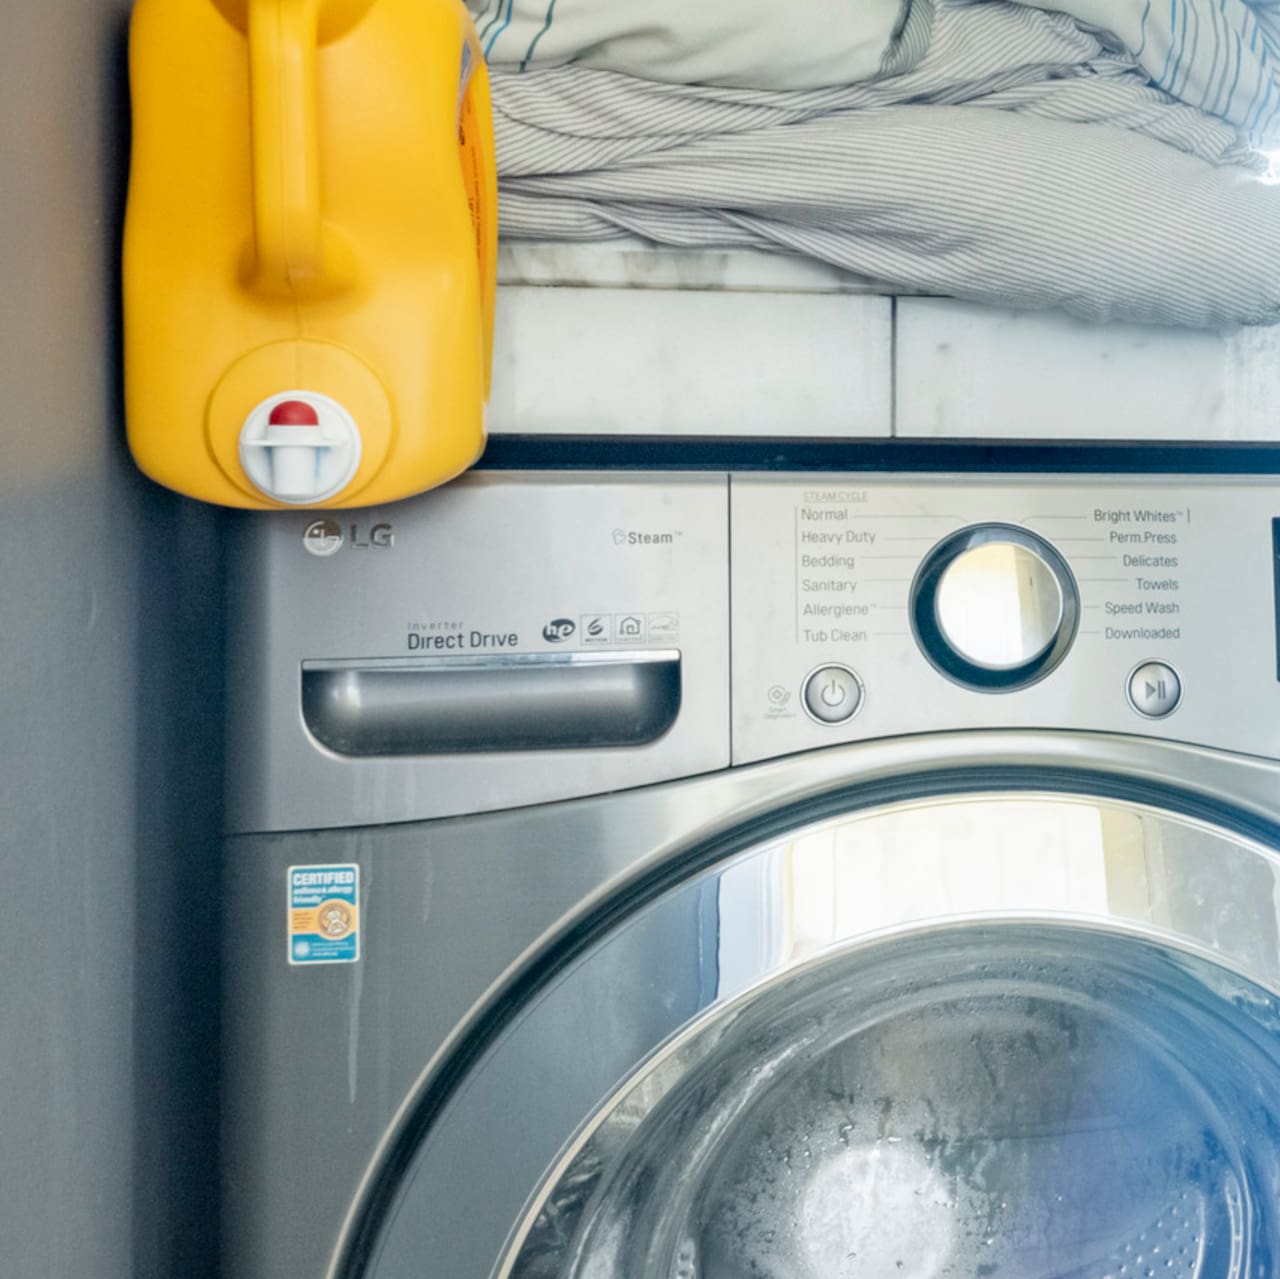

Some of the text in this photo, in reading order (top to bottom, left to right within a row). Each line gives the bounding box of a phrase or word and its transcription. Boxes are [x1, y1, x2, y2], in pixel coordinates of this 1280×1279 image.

[801, 508, 848, 520] Normal
[1094, 509, 1177, 524] Bright Whites
[350, 523, 395, 548] LG
[628, 531, 673, 544] Steam
[801, 529, 876, 545] Heavy Duty
[802, 554, 855, 569] Bedding
[1123, 554, 1178, 567] Delicates
[802, 579, 857, 593] Sanitary
[1136, 577, 1179, 591] Towels
[1105, 601, 1180, 616] Speed Wash
[804, 628, 867, 641] Tub Clean
[1105, 626, 1180, 639] Downloaded
[407, 631, 518, 650] Direct Drive
[293, 872, 354, 886] CERTIFIED
